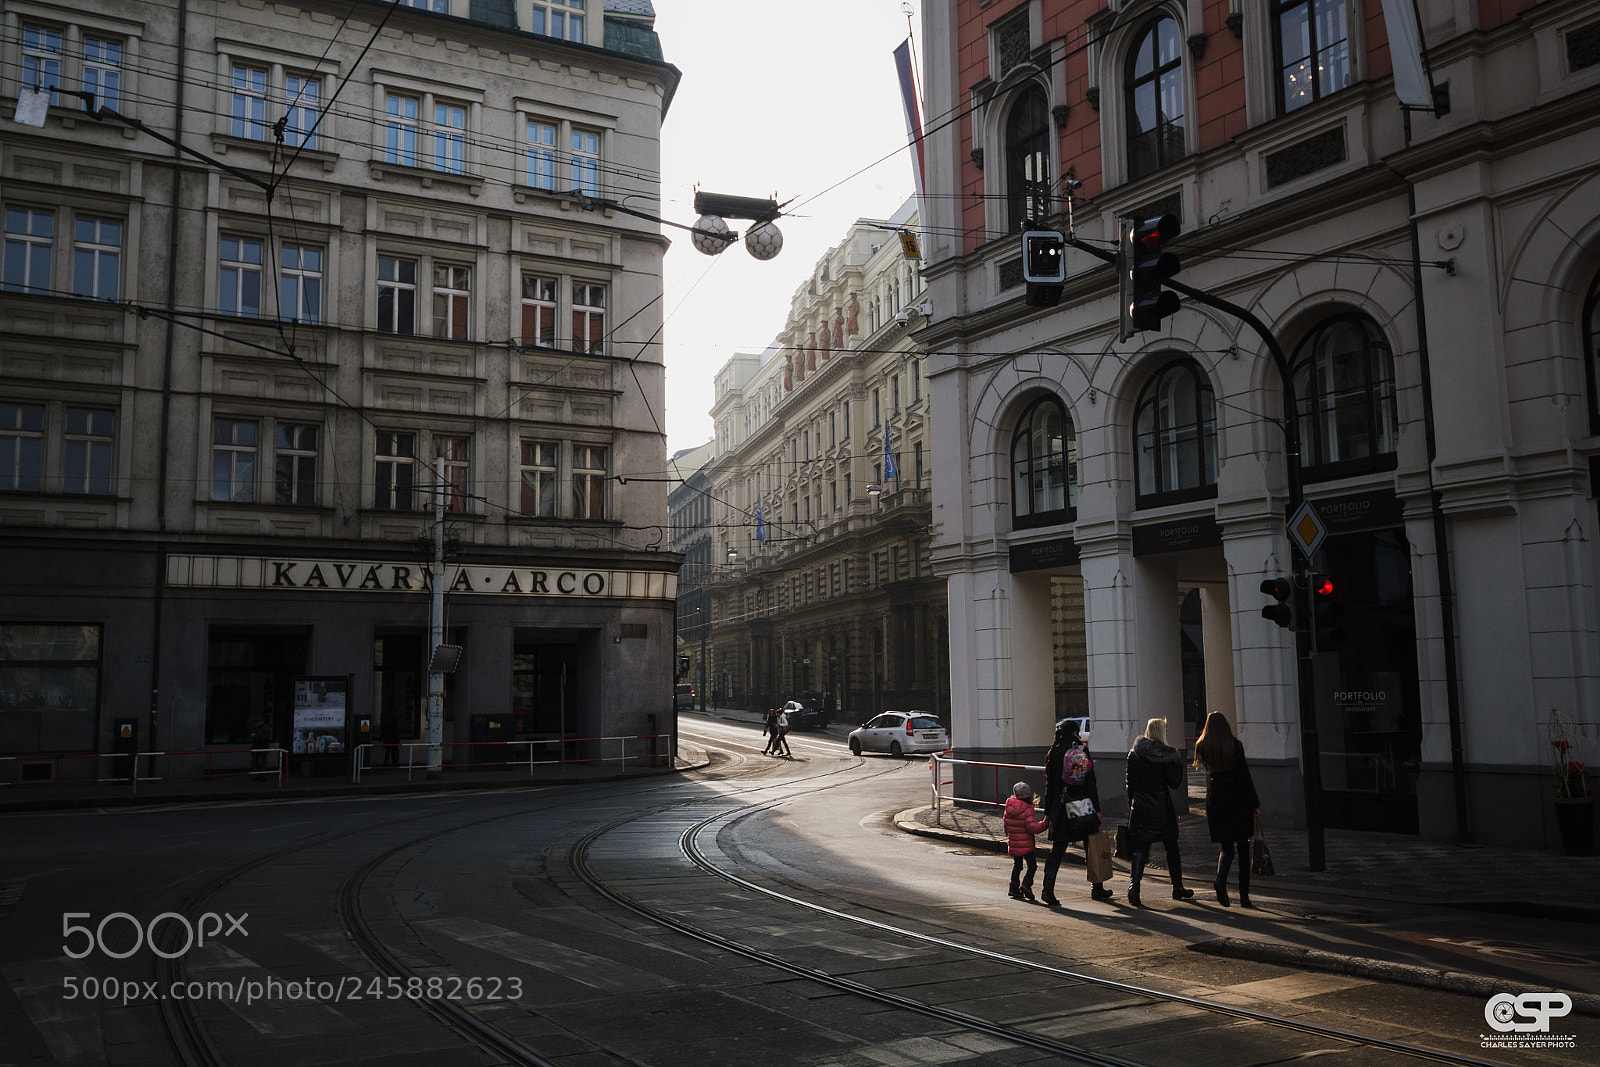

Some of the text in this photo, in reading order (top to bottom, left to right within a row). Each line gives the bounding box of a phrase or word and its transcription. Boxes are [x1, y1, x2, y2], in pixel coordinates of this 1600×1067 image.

[906, 241, 916, 252] 15
[1320, 500, 1370, 514] PORTFOLIO
[1160, 525, 1199, 537] PORTFOLIO
[500, 570, 605, 595] ARCO
[1334, 691, 1386, 701] PORTFOLIO
